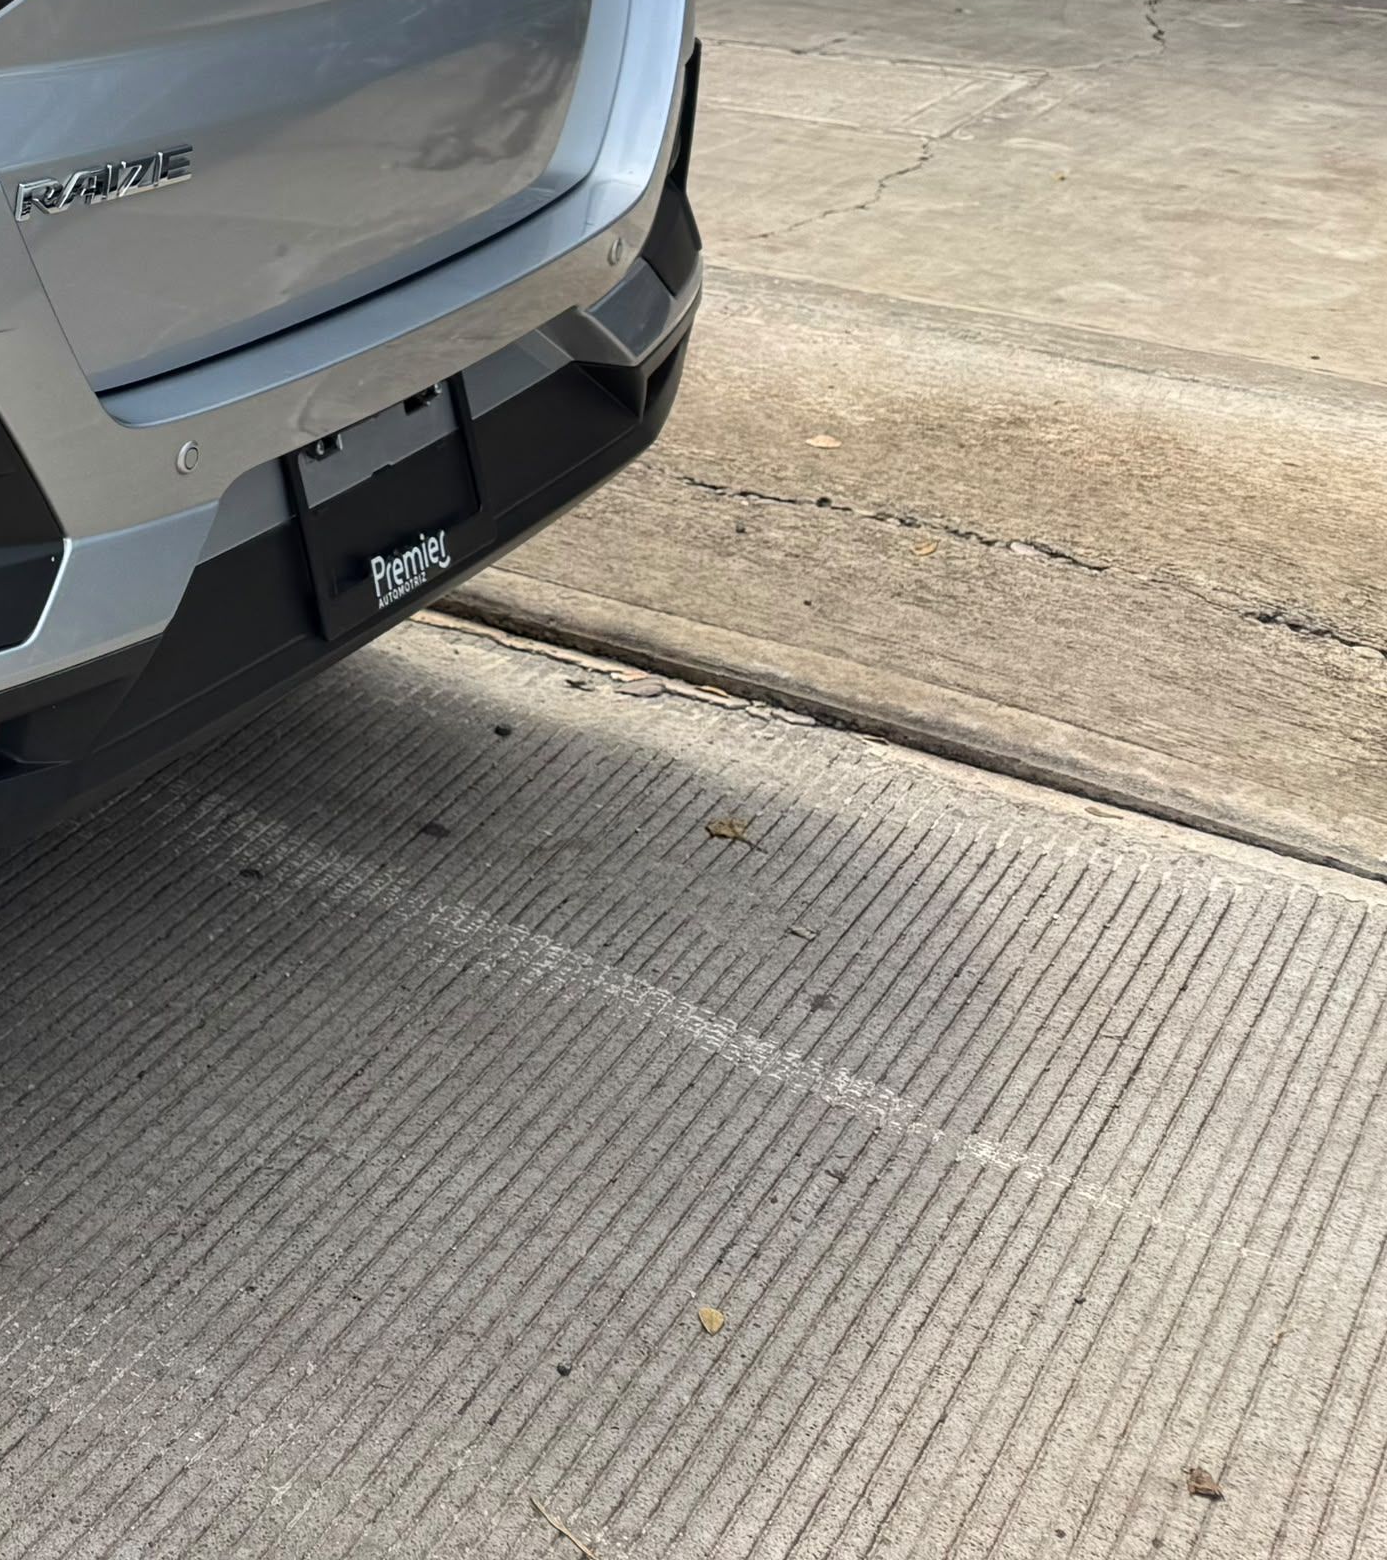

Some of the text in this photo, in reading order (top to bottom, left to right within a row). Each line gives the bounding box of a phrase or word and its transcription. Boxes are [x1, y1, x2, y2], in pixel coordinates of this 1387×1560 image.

[15, 143, 193, 222] RAIZE
[370, 529, 451, 598] Premier
[378, 571, 428, 610] AUTOMOTRIZ
